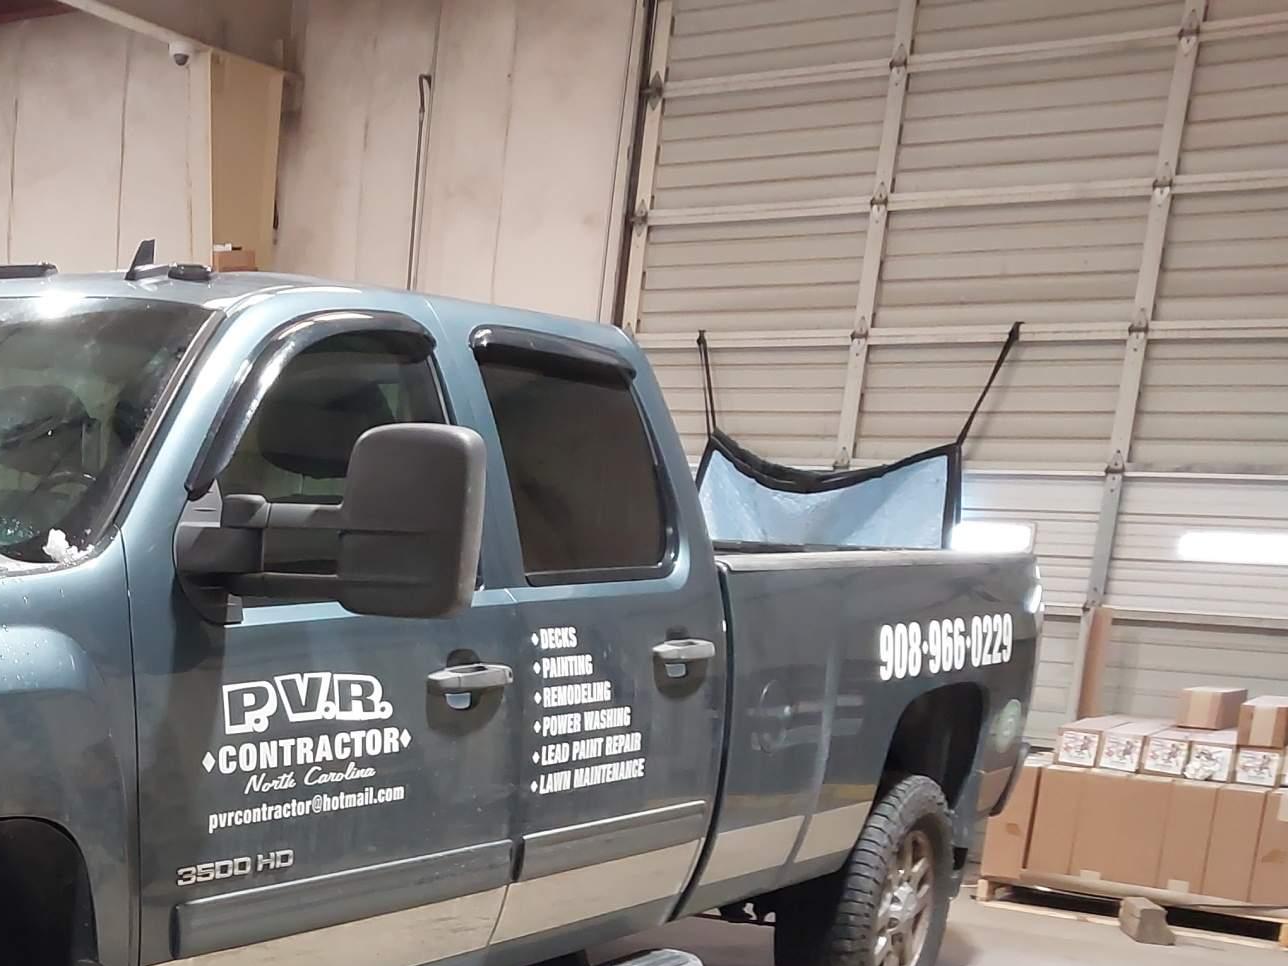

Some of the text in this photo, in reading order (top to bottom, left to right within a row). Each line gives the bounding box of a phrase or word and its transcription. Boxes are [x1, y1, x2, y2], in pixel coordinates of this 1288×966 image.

[540, 627, 578, 650] DECKS
[542, 654, 593, 679] PAINTING
[222, 672, 393, 734] P.V.R.
[543, 681, 612, 708] REMODELING
[542, 706, 632, 737] POWER WASHING
[218, 726, 400, 774] CONTRACTOR
[541, 732, 642, 766] LEAD PAINT REPAIR
[244, 762, 376, 795] North Carolina
[539, 758, 646, 795] LAWN MAINTENANCE
[208, 786, 405, 834] pvrcontractor@hotmail.com
[177, 850, 294, 886] 3500 HD
